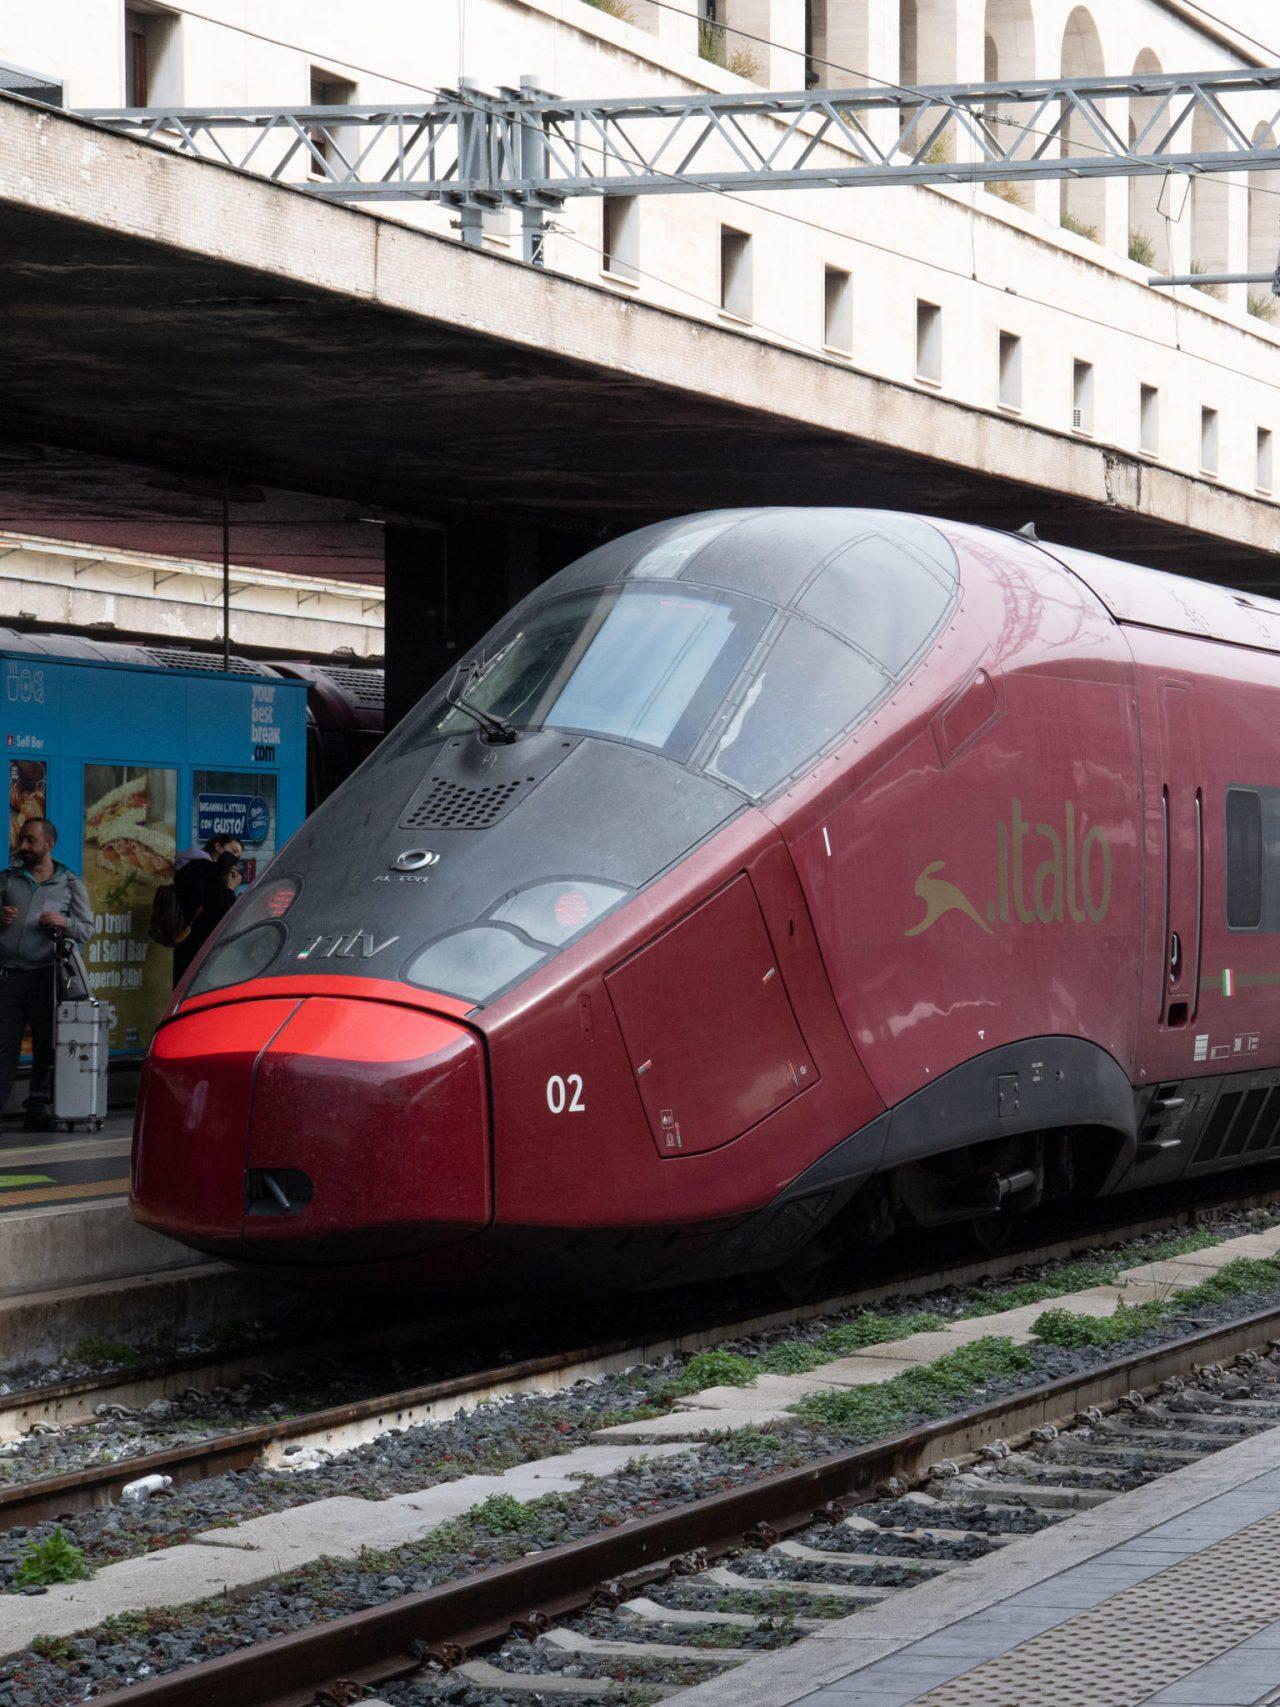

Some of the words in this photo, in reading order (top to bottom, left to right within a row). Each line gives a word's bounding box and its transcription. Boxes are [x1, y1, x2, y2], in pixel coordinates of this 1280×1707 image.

[252, 685, 276, 703] your
[252, 702, 273, 723] best
[16, 735, 31, 748] Self
[31, 736, 44, 748] Bar
[252, 723, 280, 744] break
[251, 744, 276, 762] .com
[199, 802, 224, 813] INGANNA
[200, 819, 213, 829] CON
[213, 816, 245, 835] GUSTO!
[373, 875, 430, 883] ALTOM
[105, 911, 132, 933] trovi
[89, 939, 100, 963] al
[103, 938, 126, 963] Self
[128, 939, 148, 962] Bar
[88, 969, 121, 989] aperto
[121, 967, 143, 988] 24h!
[546, 1073, 586, 1114] 02
